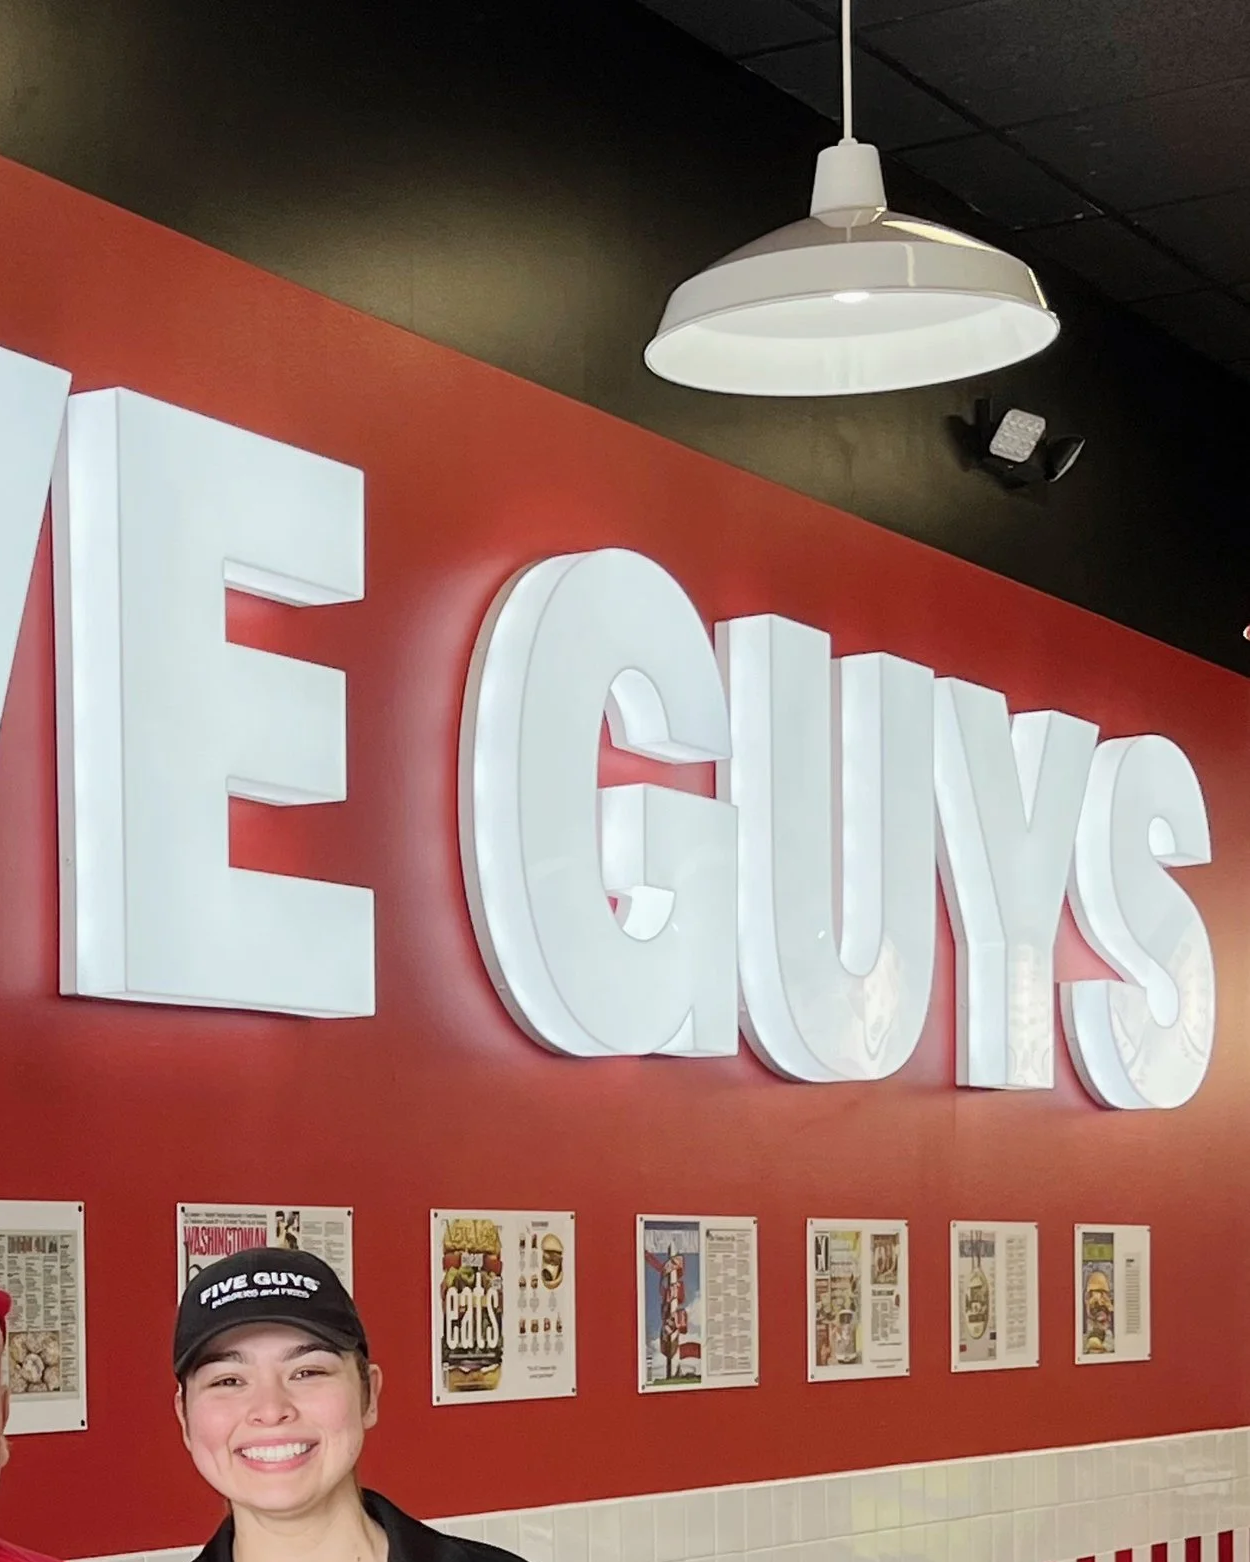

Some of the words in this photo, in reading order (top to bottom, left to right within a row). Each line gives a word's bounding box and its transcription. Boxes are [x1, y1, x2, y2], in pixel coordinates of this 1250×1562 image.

[459, 548, 1216, 1110] GUYS
[183, 1226, 267, 1256] WASHINGTONIAN
[200, 1274, 248, 1305] FIVE
[253, 1272, 319, 1292] GUYS
[446, 1272, 499, 1350] eats
